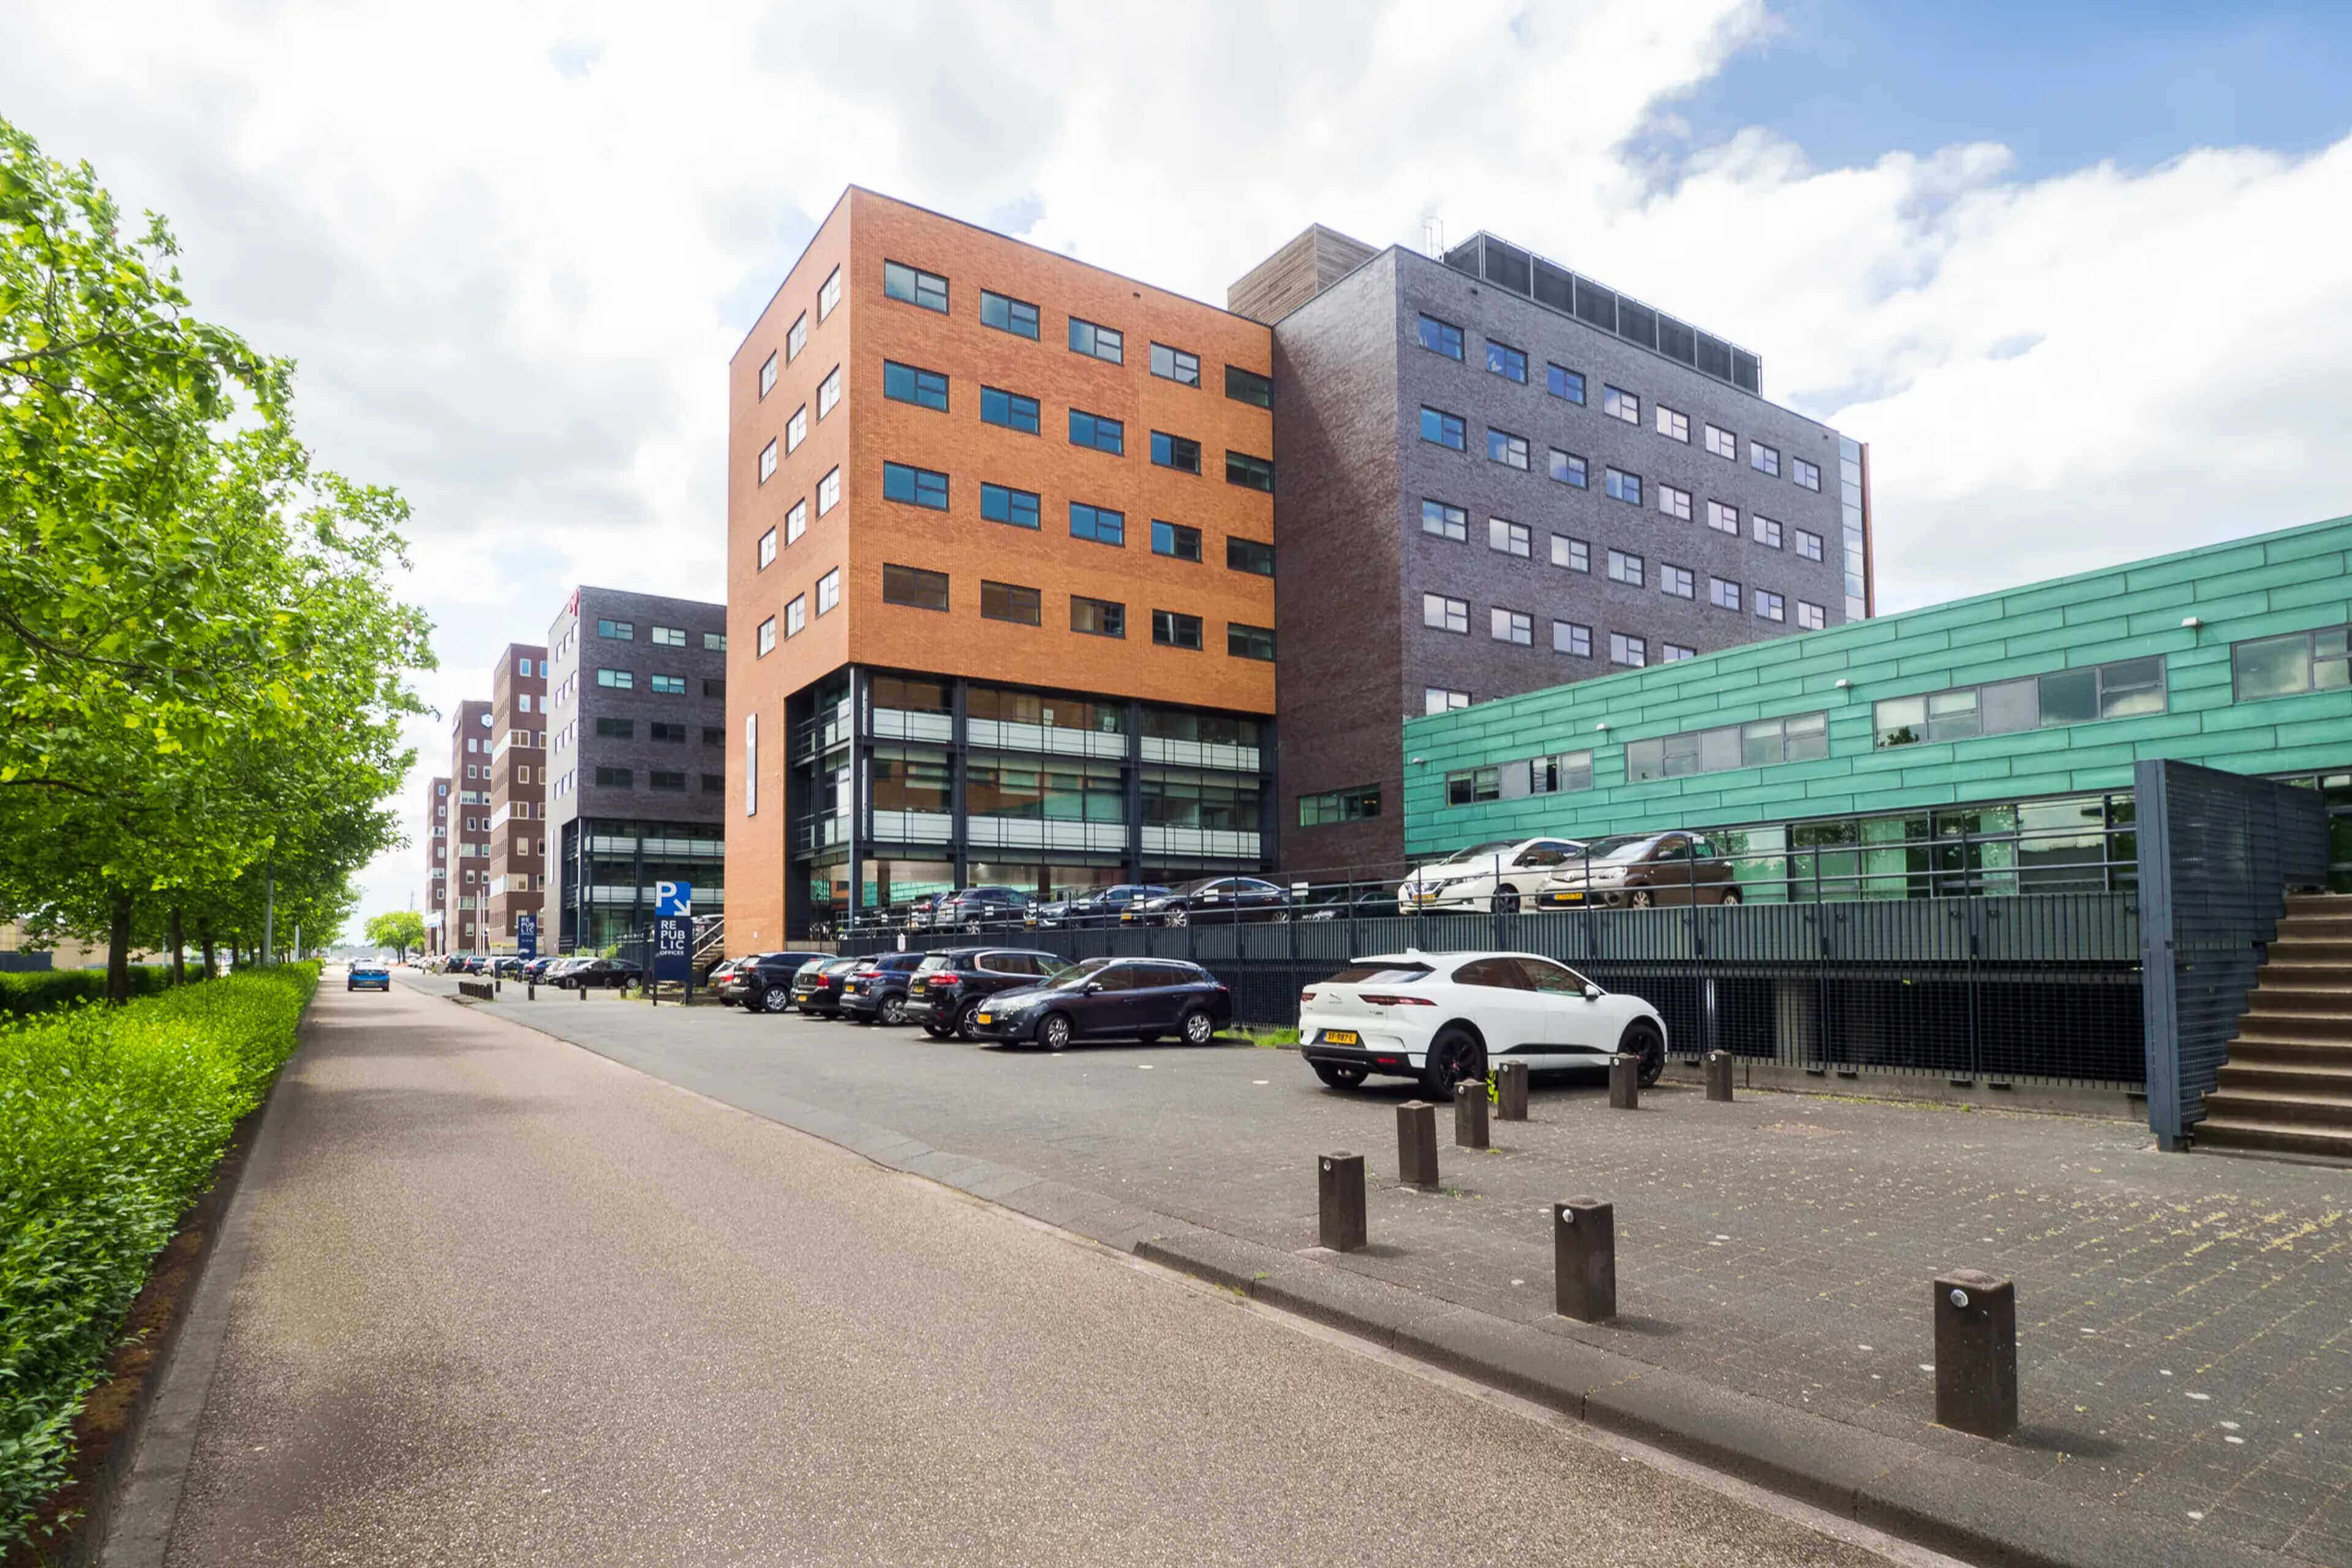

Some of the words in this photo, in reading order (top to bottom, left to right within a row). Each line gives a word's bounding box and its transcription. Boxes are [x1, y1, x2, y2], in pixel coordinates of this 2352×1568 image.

[656, 881, 677, 907] P
[661, 920, 676, 930] RE
[661, 930, 685, 940] PUB
[661, 940, 684, 949] LIC
